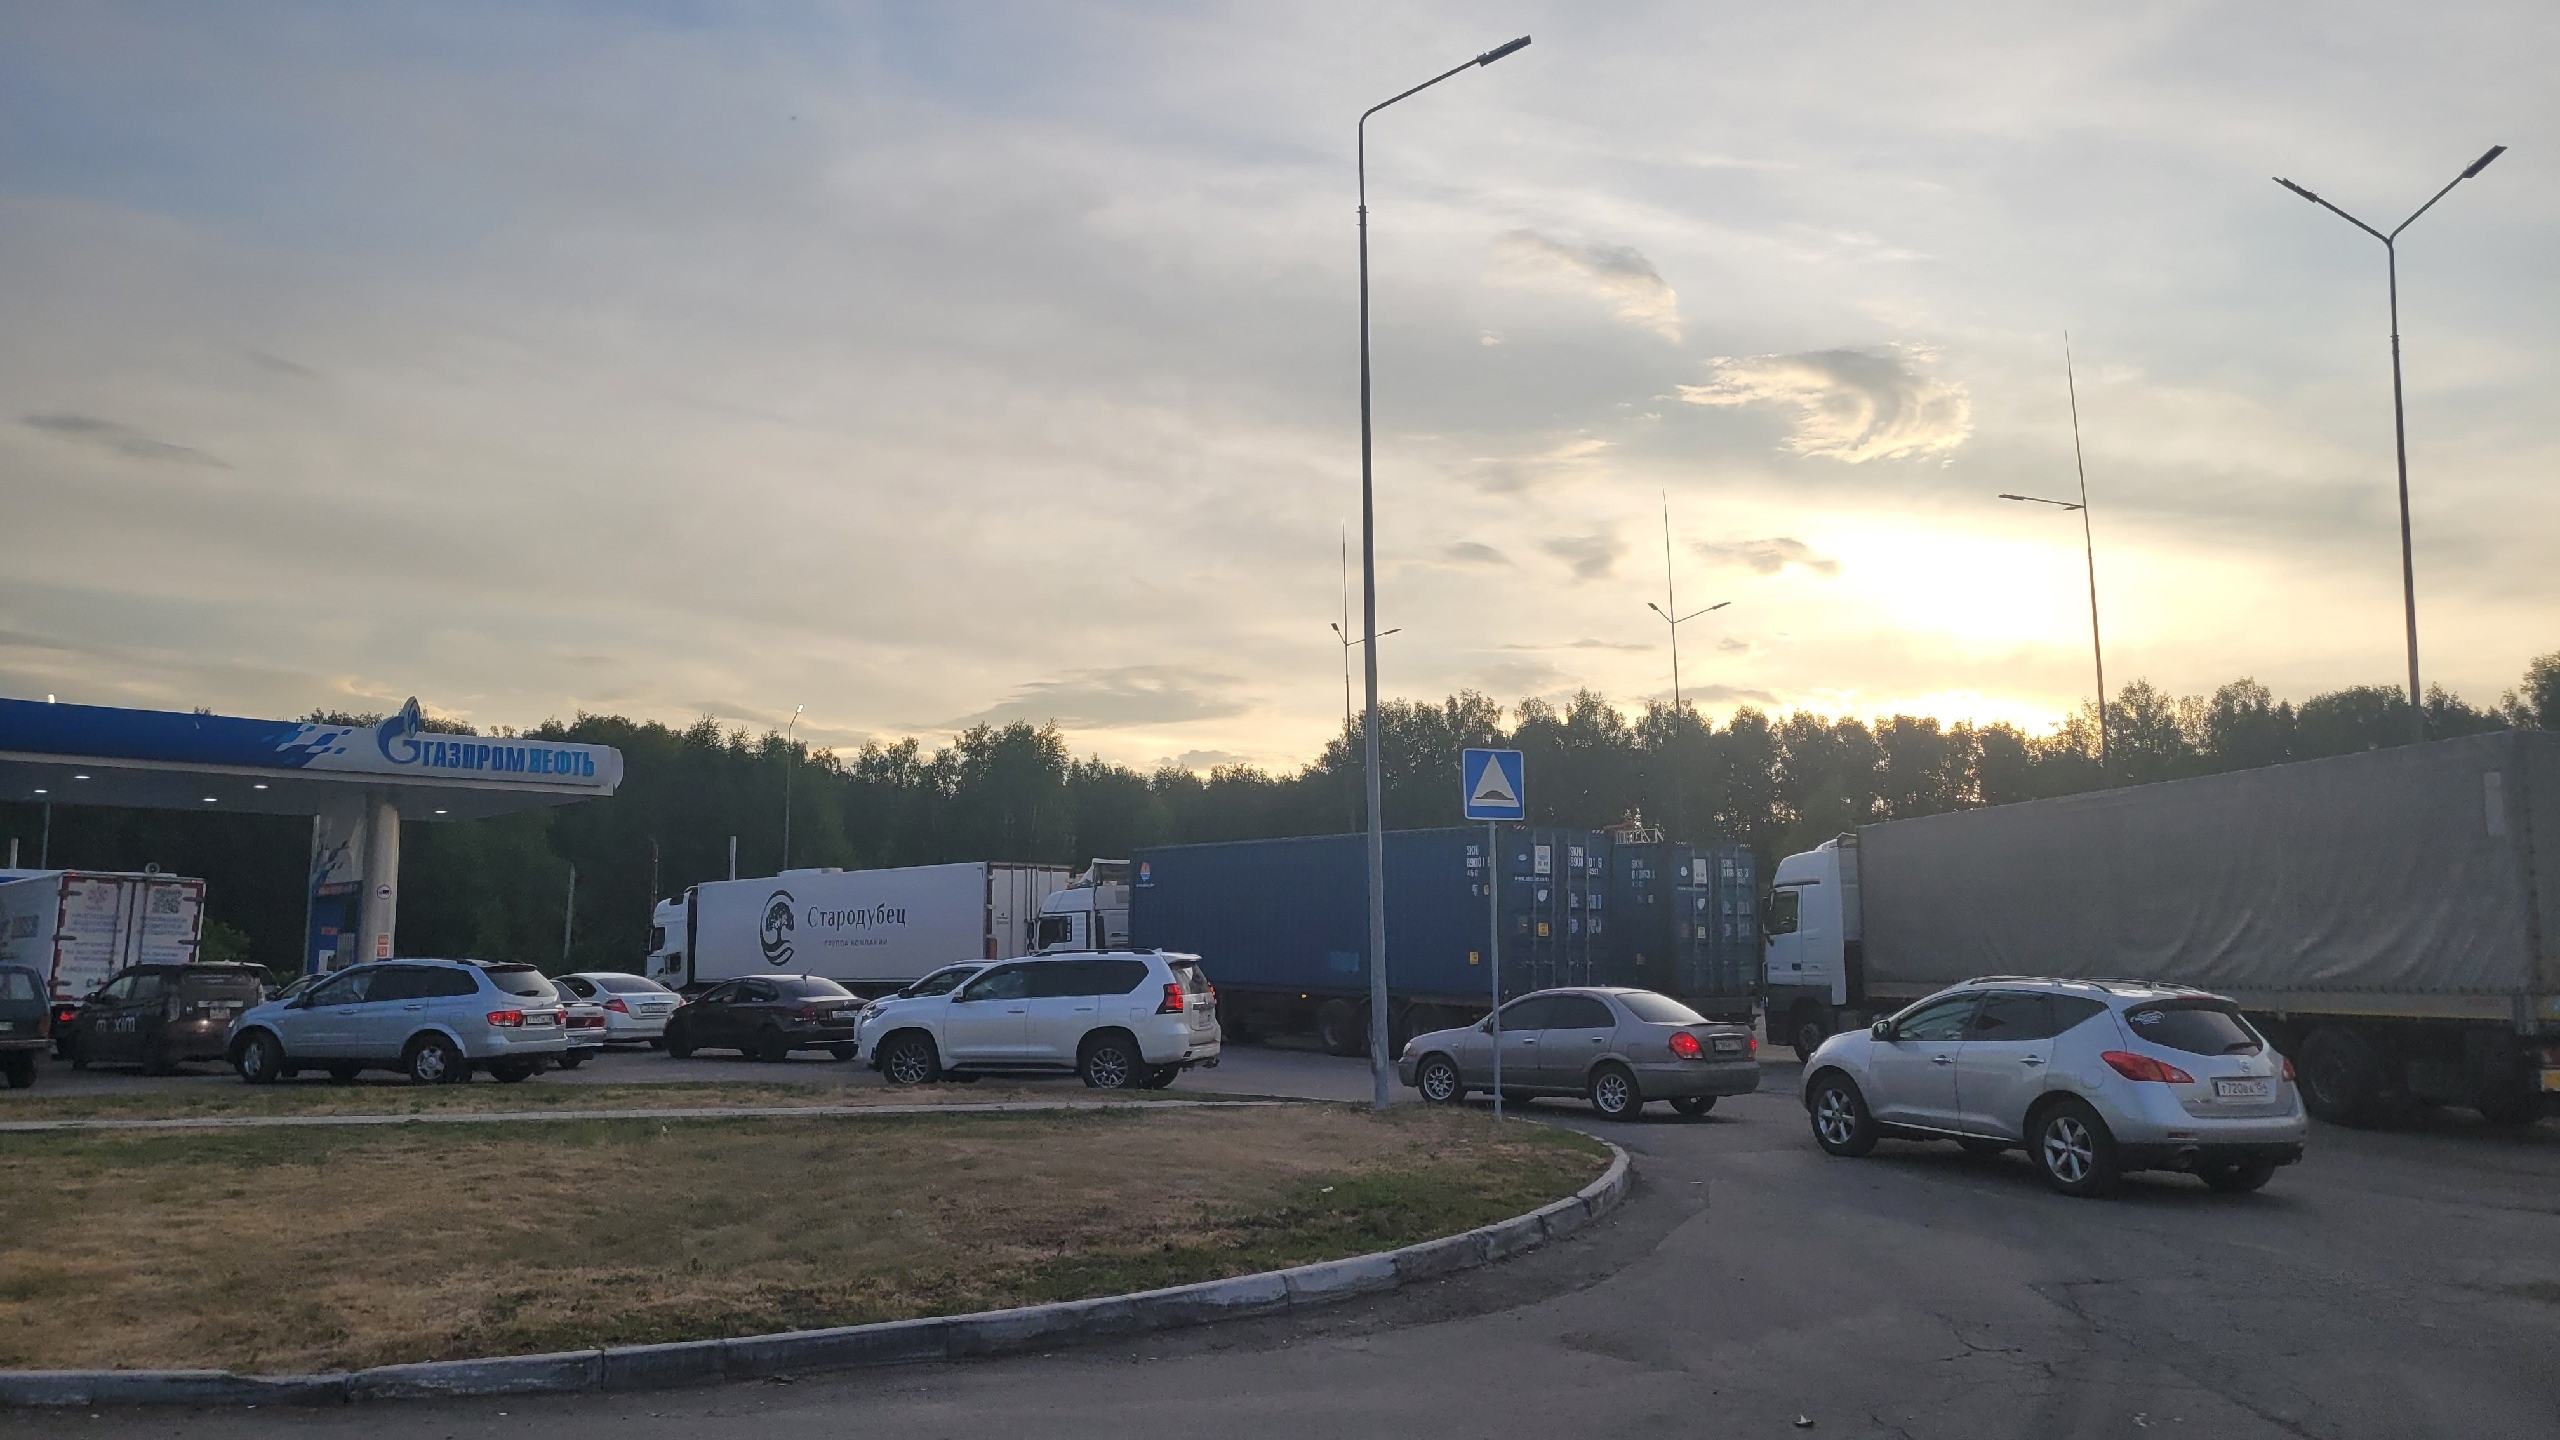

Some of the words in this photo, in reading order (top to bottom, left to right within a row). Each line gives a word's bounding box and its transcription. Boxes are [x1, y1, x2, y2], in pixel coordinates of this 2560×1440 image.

[422, 741, 525, 773] ГАЗПРОМ
[528, 748, 595, 777] НЕФТЬ
[807, 902, 906, 931] Стародубец
[96, 1012, 136, 1032] mxim
